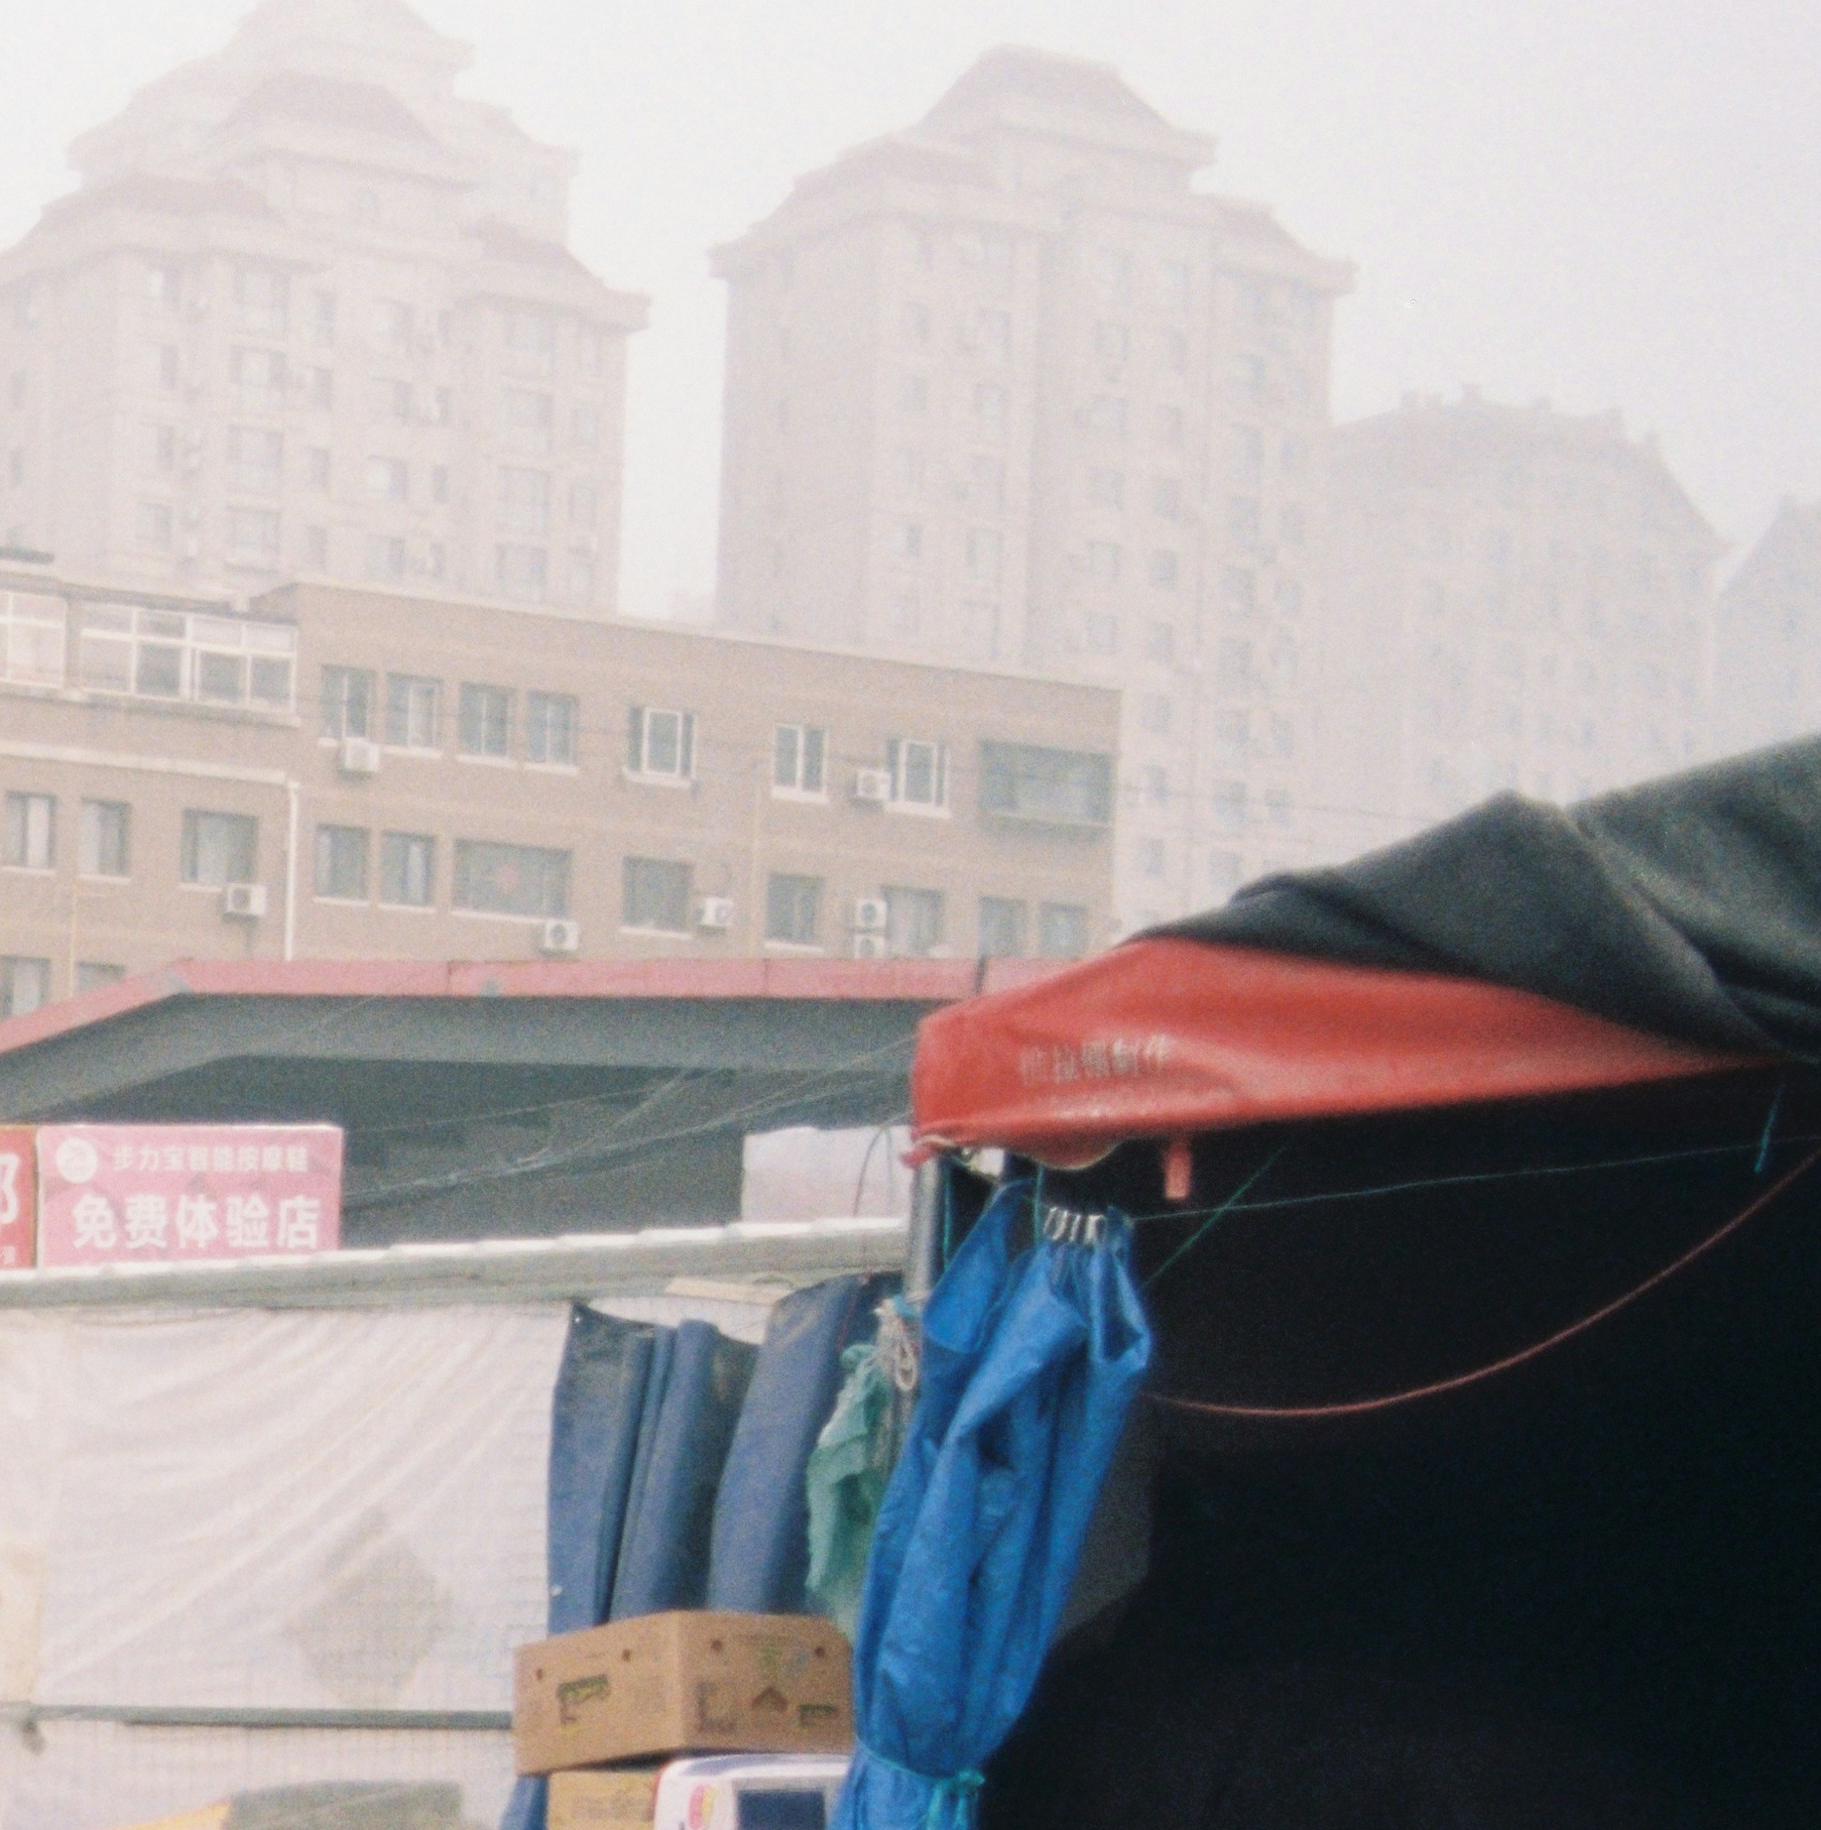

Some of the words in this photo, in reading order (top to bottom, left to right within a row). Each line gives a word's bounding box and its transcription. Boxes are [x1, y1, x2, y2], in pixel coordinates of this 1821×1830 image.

[73, 1193, 320, 1250] 免费体验店
